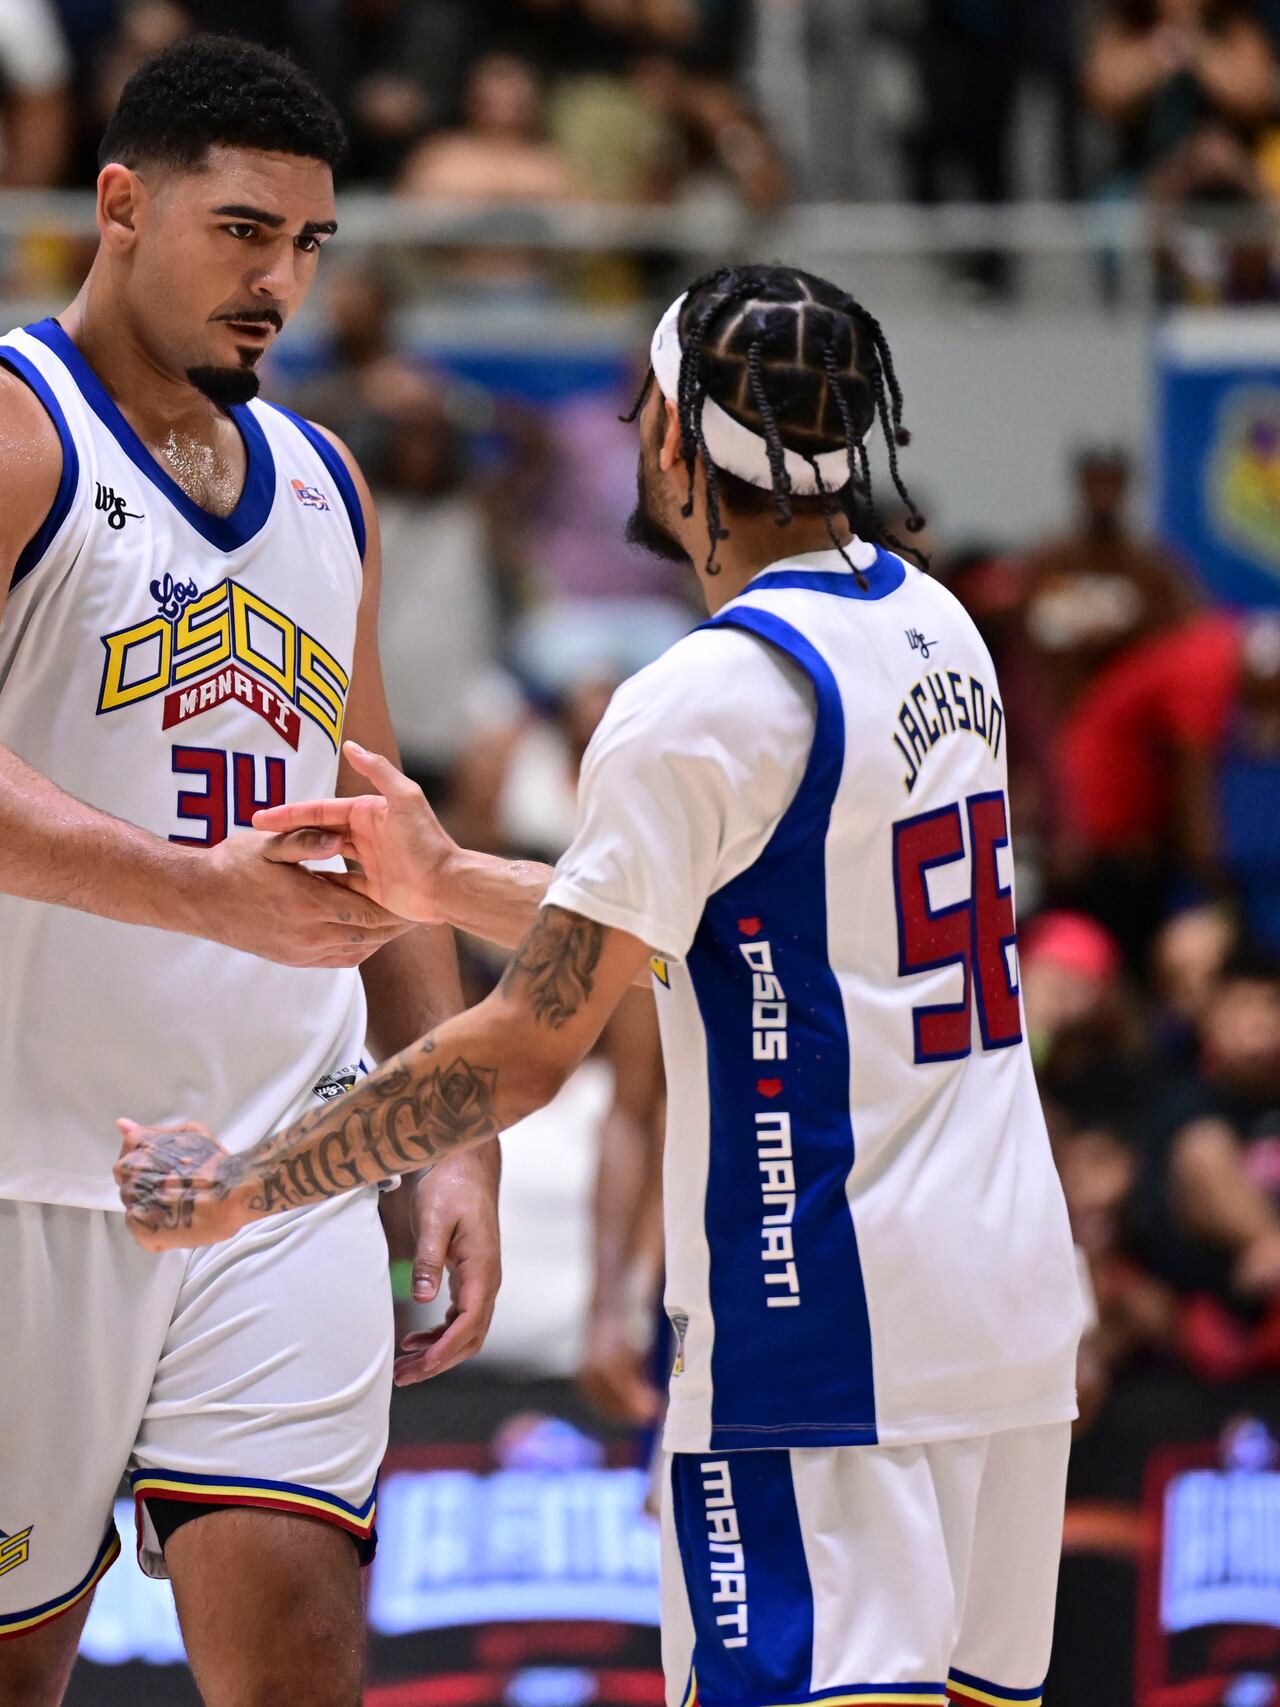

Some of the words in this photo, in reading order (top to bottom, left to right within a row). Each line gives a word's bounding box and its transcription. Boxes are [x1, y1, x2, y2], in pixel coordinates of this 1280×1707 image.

[150, 572, 198, 617] Los
[96, 577, 349, 754] OSOS
[178, 667, 291, 733] MANATI
[892, 670, 1003, 793] JACKSON
[169, 744, 286, 848] 34
[738, 940, 789, 1061] OSOS
[755, 1111, 801, 1308] MANATI
[700, 1460, 749, 1650] MANATI
